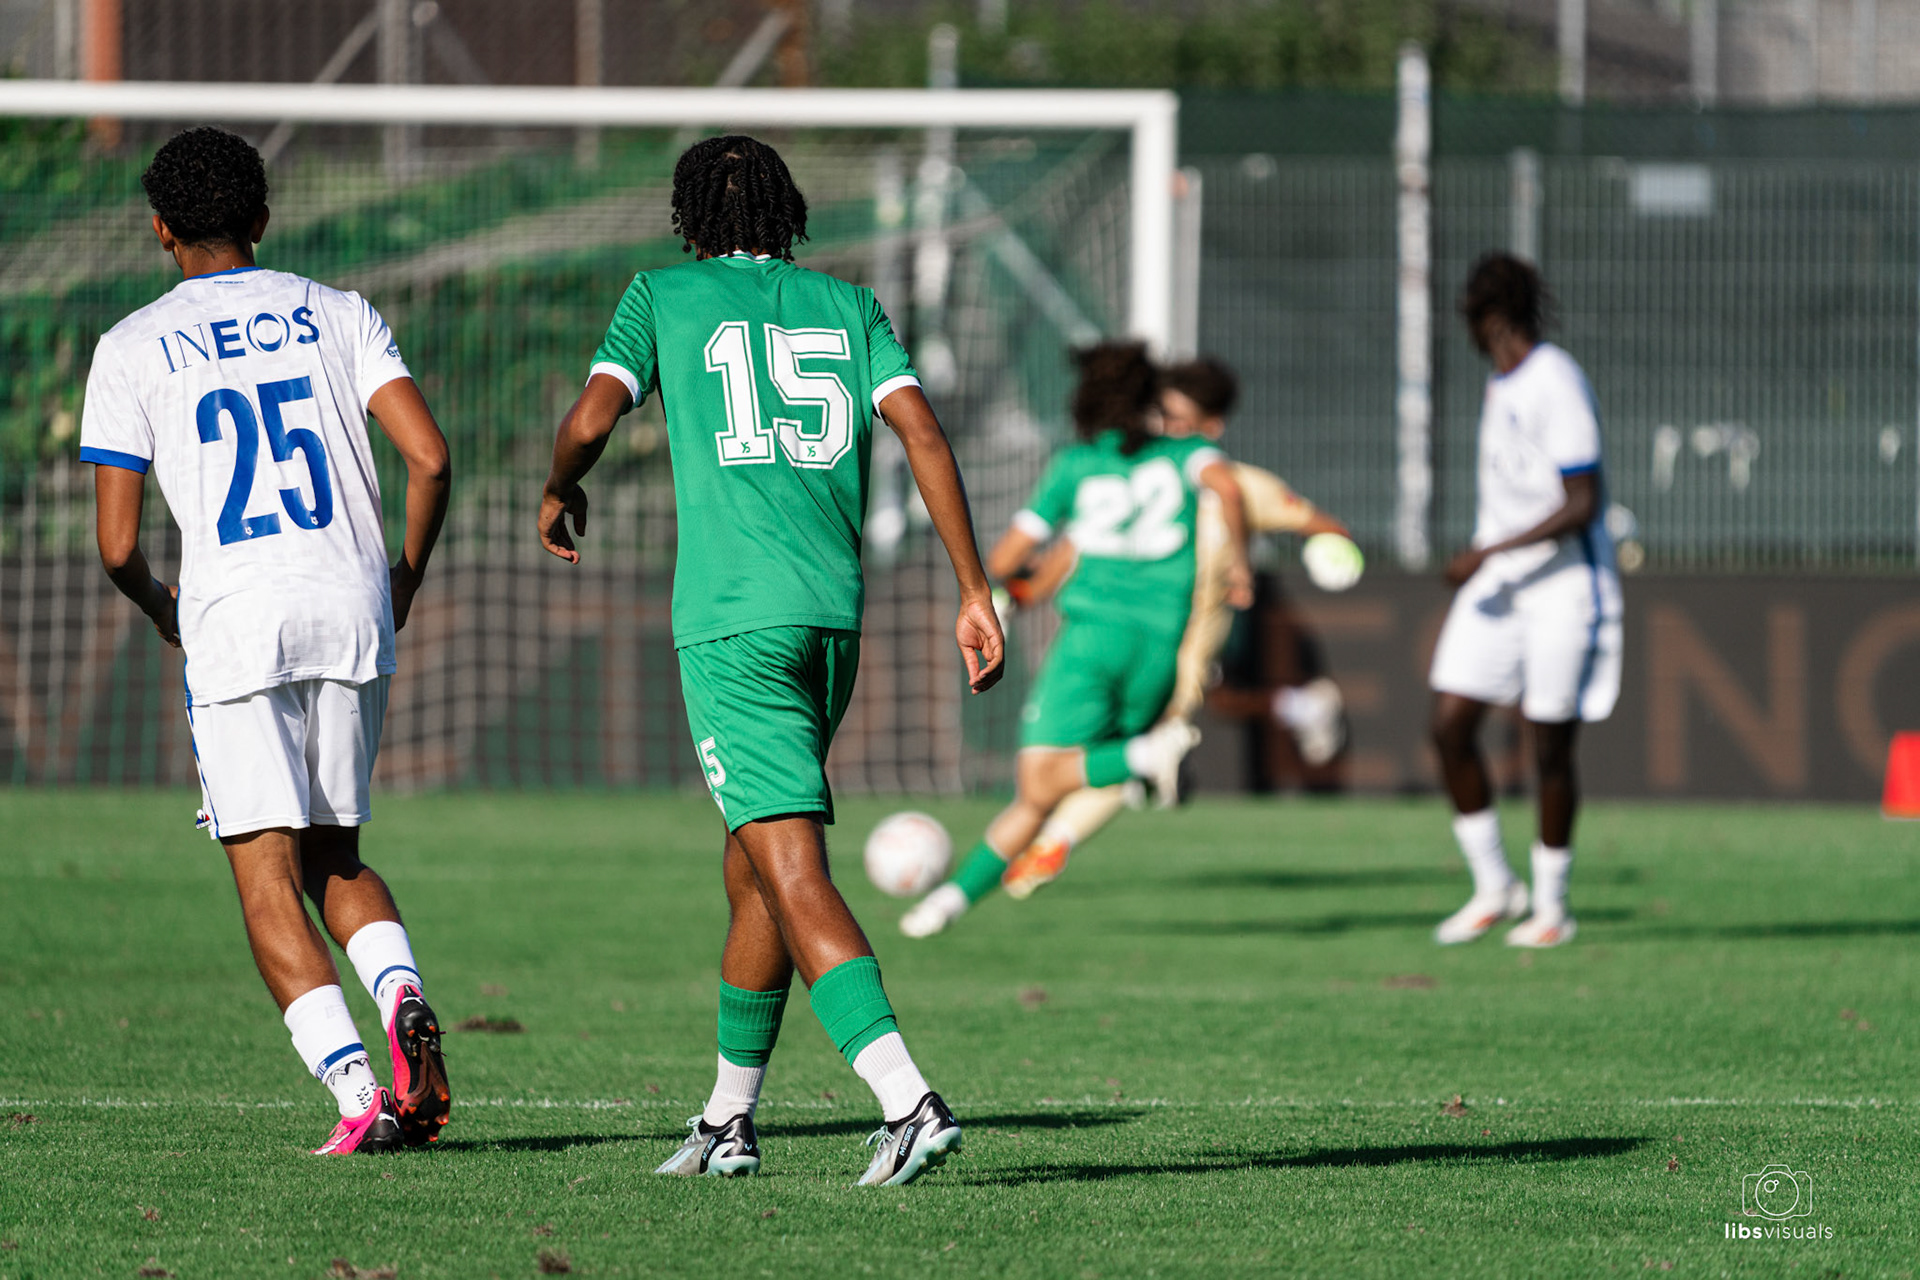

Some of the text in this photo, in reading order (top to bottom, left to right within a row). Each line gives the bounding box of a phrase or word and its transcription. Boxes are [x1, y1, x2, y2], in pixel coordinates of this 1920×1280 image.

[158, 305, 320, 374] INEOS
[704, 321, 853, 469] 15
[196, 375, 333, 546] 25
[1067, 456, 1188, 561] 22
[899, 1124, 915, 1157] MESSI
